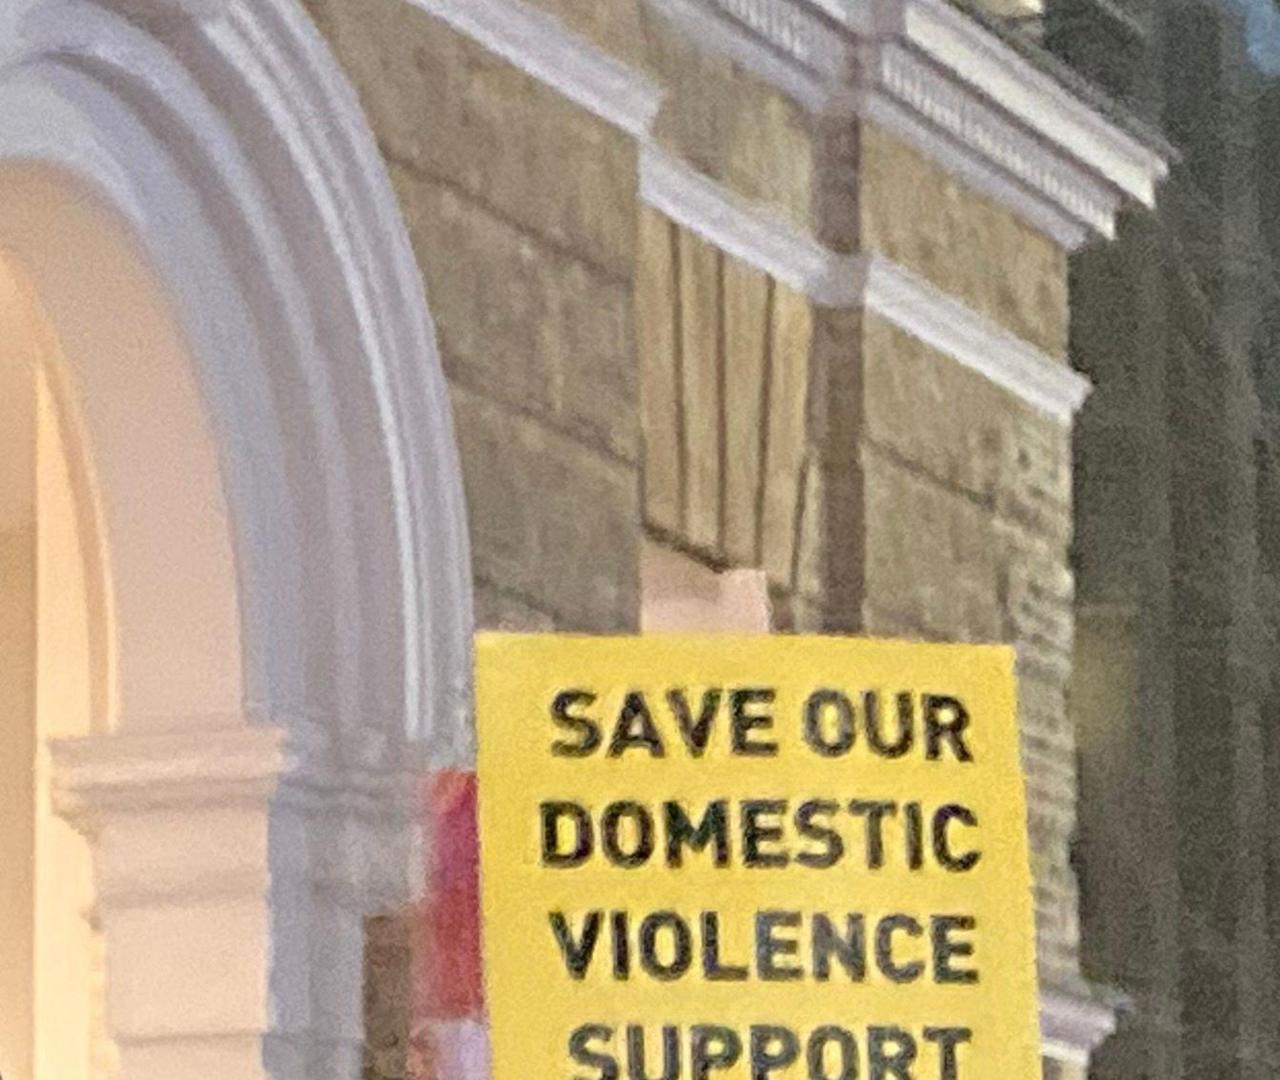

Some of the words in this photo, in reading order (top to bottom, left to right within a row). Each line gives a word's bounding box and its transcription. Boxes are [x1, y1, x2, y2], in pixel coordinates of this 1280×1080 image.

[549, 687, 779, 759] SAVE
[803, 689, 974, 762] OUR
[539, 798, 982, 871] DOMESTIC
[548, 909, 979, 984] VIOLENCE
